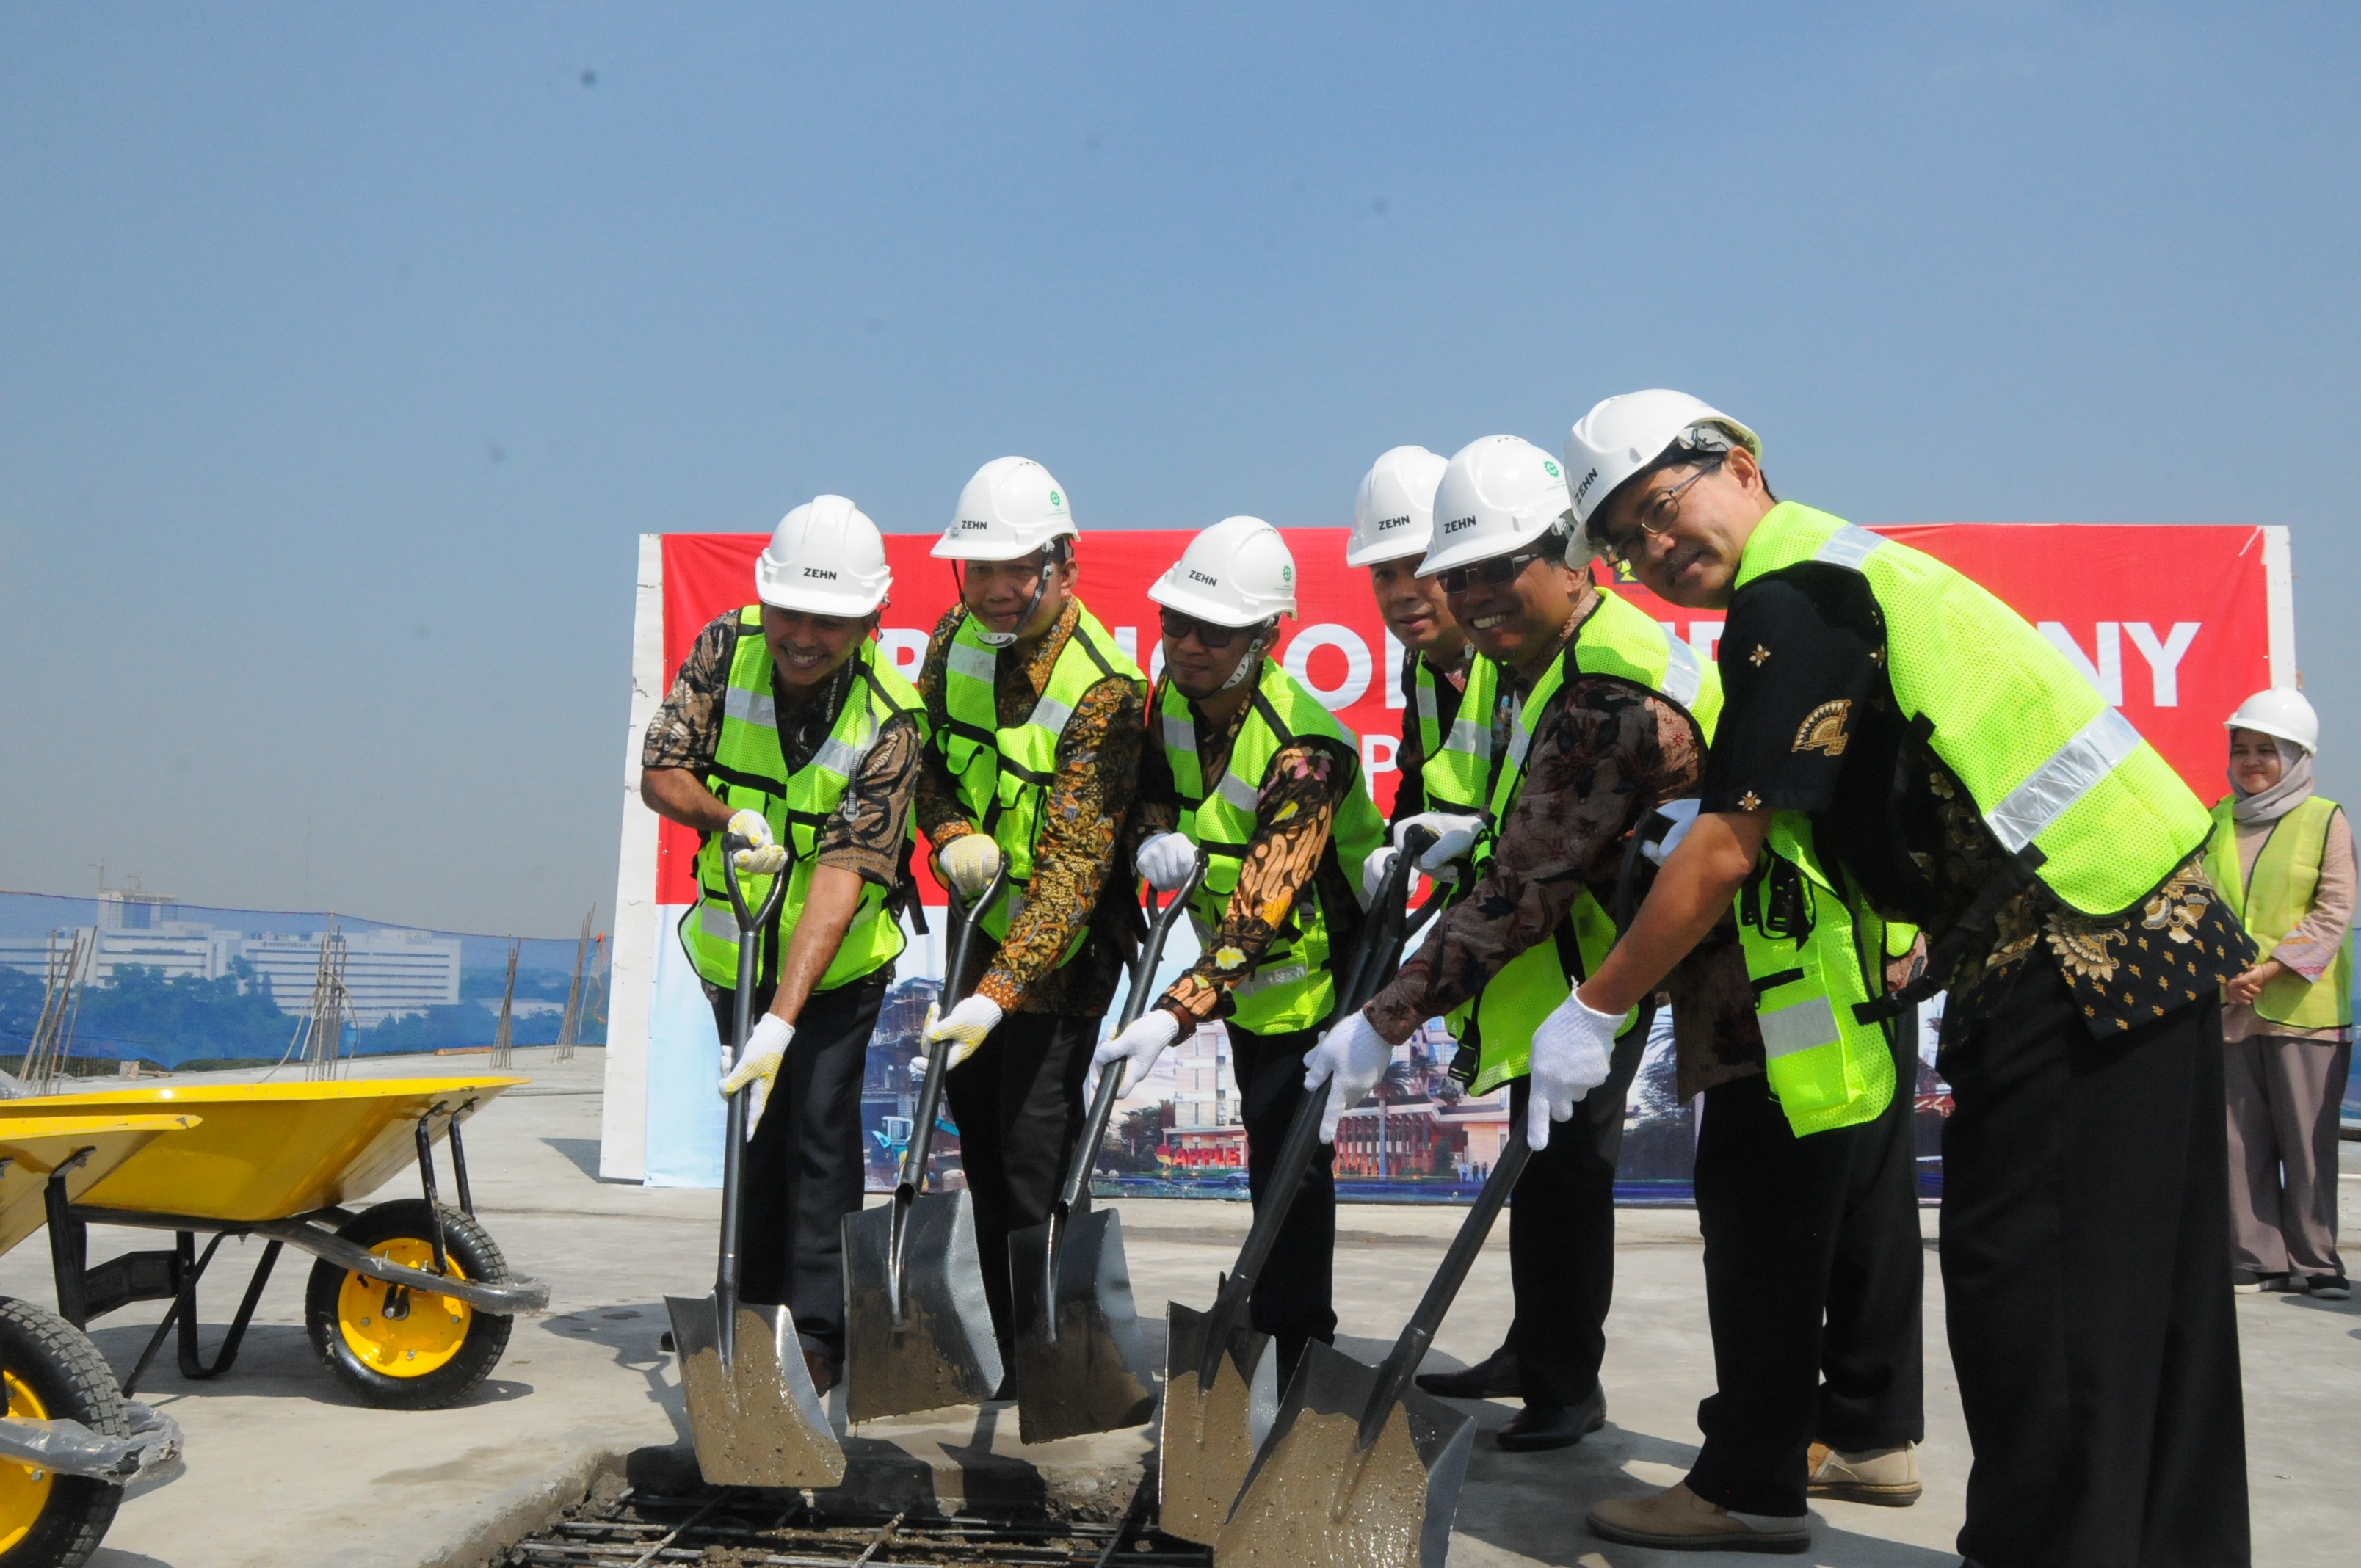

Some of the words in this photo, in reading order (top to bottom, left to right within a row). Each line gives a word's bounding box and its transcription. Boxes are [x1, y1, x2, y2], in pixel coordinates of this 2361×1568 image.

[1575, 468, 1598, 505] ZEHN
[961, 520, 987, 530] ZEHN
[1378, 515, 1410, 531] ZEHN
[1443, 515, 1477, 534] ZEHN
[803, 567, 837, 581] ZEHN
[1188, 570, 1217, 587] ZEHN
[1172, 1147, 1241, 1166] APPLE
